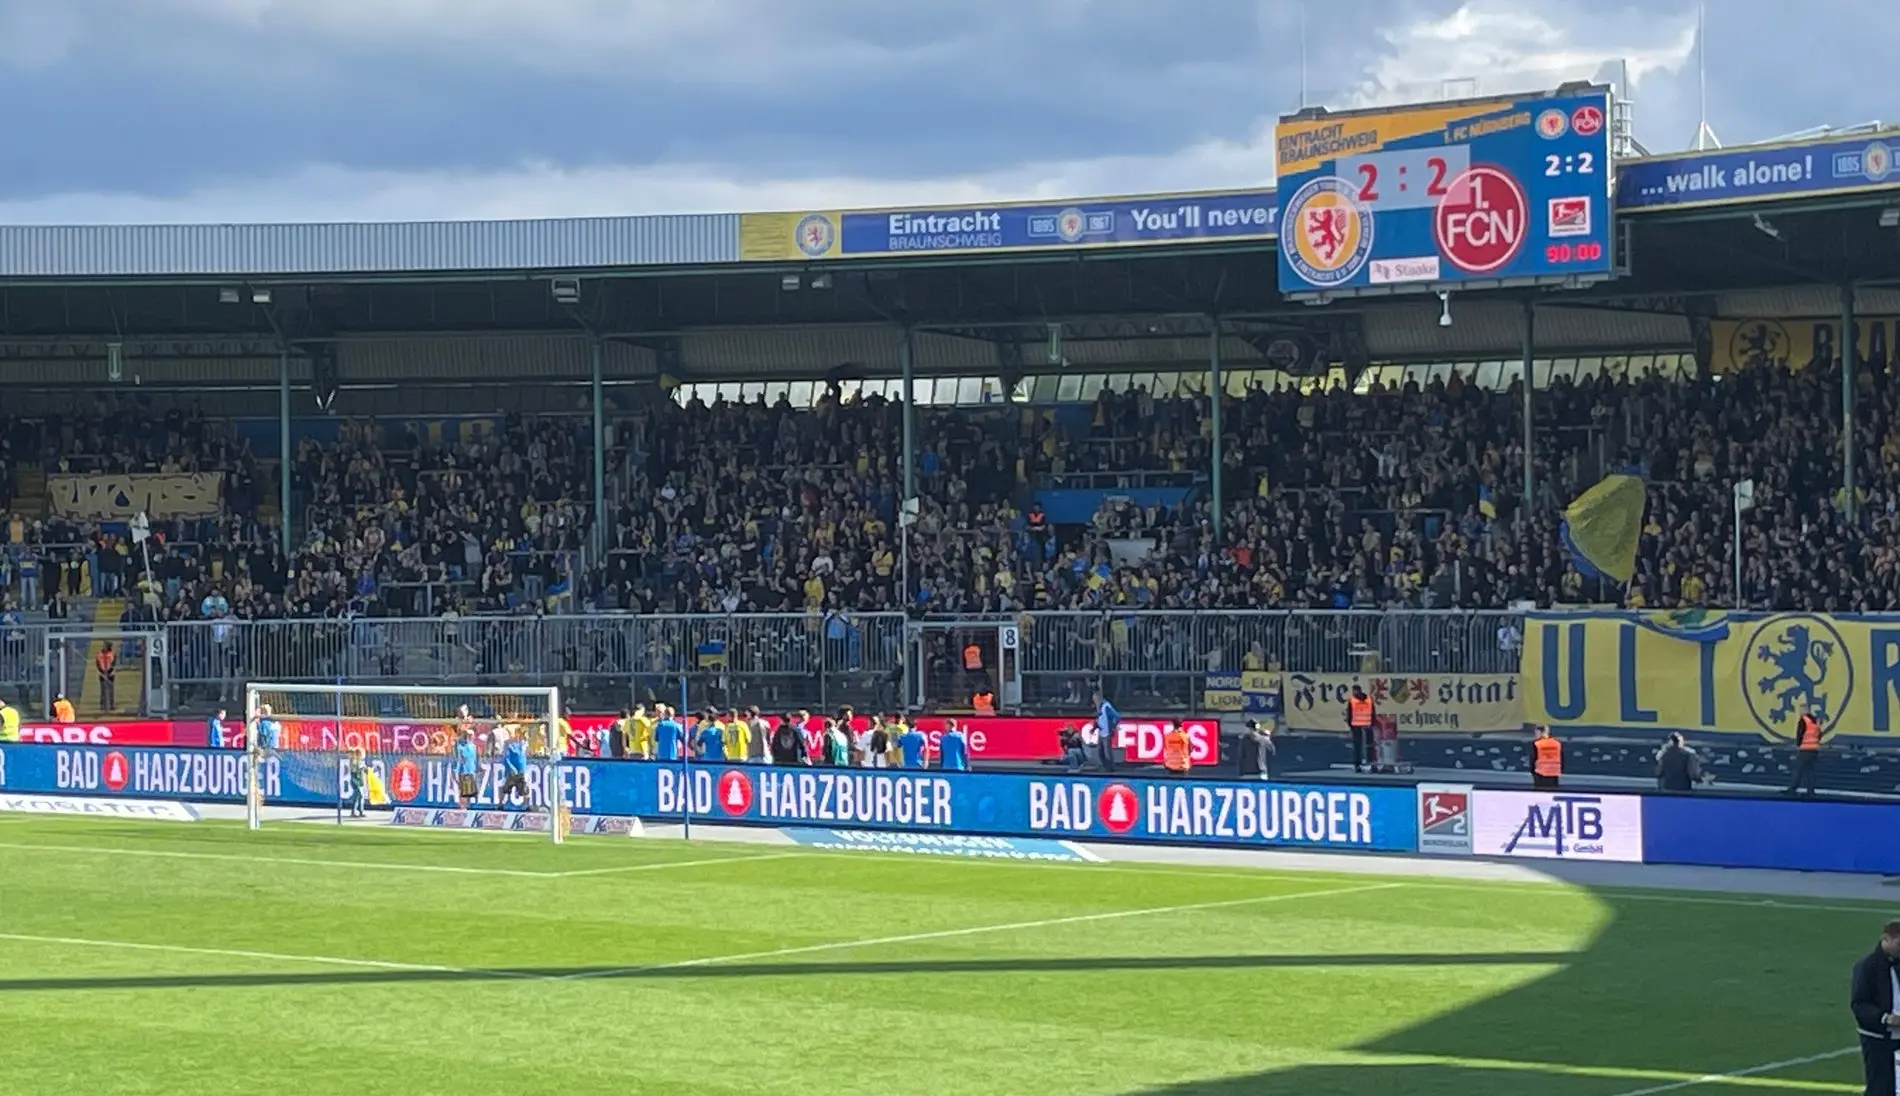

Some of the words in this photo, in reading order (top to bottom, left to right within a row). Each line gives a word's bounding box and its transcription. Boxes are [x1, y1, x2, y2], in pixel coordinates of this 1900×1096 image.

[1279, 124, 1344, 150] EINTRACHT
[1280, 129, 1378, 164] BRAUNSCHWEIG
[1733, 155, 1813, 187] alone!
[889, 211, 1000, 235] Eintracht
[1131, 205, 1200, 231] You'll
[1207, 207, 1278, 227] never
[1447, 209, 1514, 248] FCN
[889, 232, 1000, 250] BRAUNSCHWEIG
[153, 639, 164, 654] 9
[1005, 628, 1016, 646] 8
[1117, 723, 1209, 760] FDS
[56, 749, 98, 789] BAD
[657, 769, 713, 815] BAD
[760, 772, 952, 825] HARZBURGER
[1029, 781, 1093, 831] BAD
[1147, 785, 1372, 844] HARZBURGER
